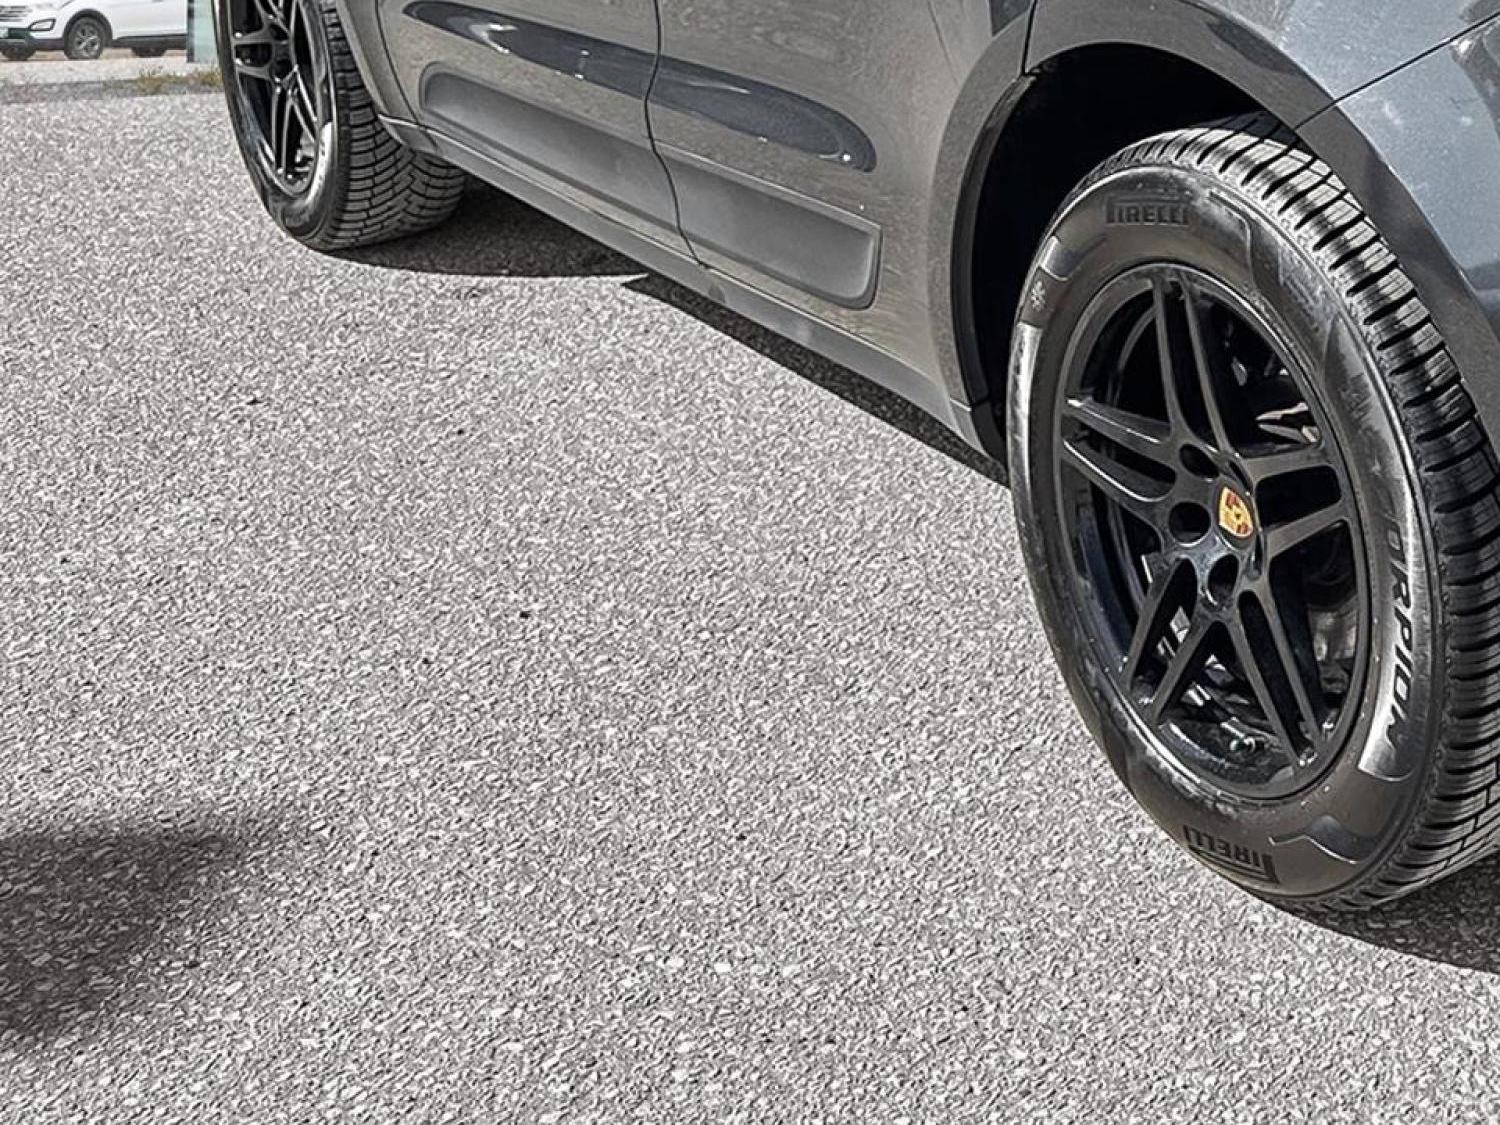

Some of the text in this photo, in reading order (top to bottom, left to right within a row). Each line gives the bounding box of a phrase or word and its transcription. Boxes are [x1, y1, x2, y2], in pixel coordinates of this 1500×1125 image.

[1106, 192, 1190, 225] PIRELLI
[1370, 457, 1414, 753] CORPION
[1183, 824, 1281, 884] PIRELLI
